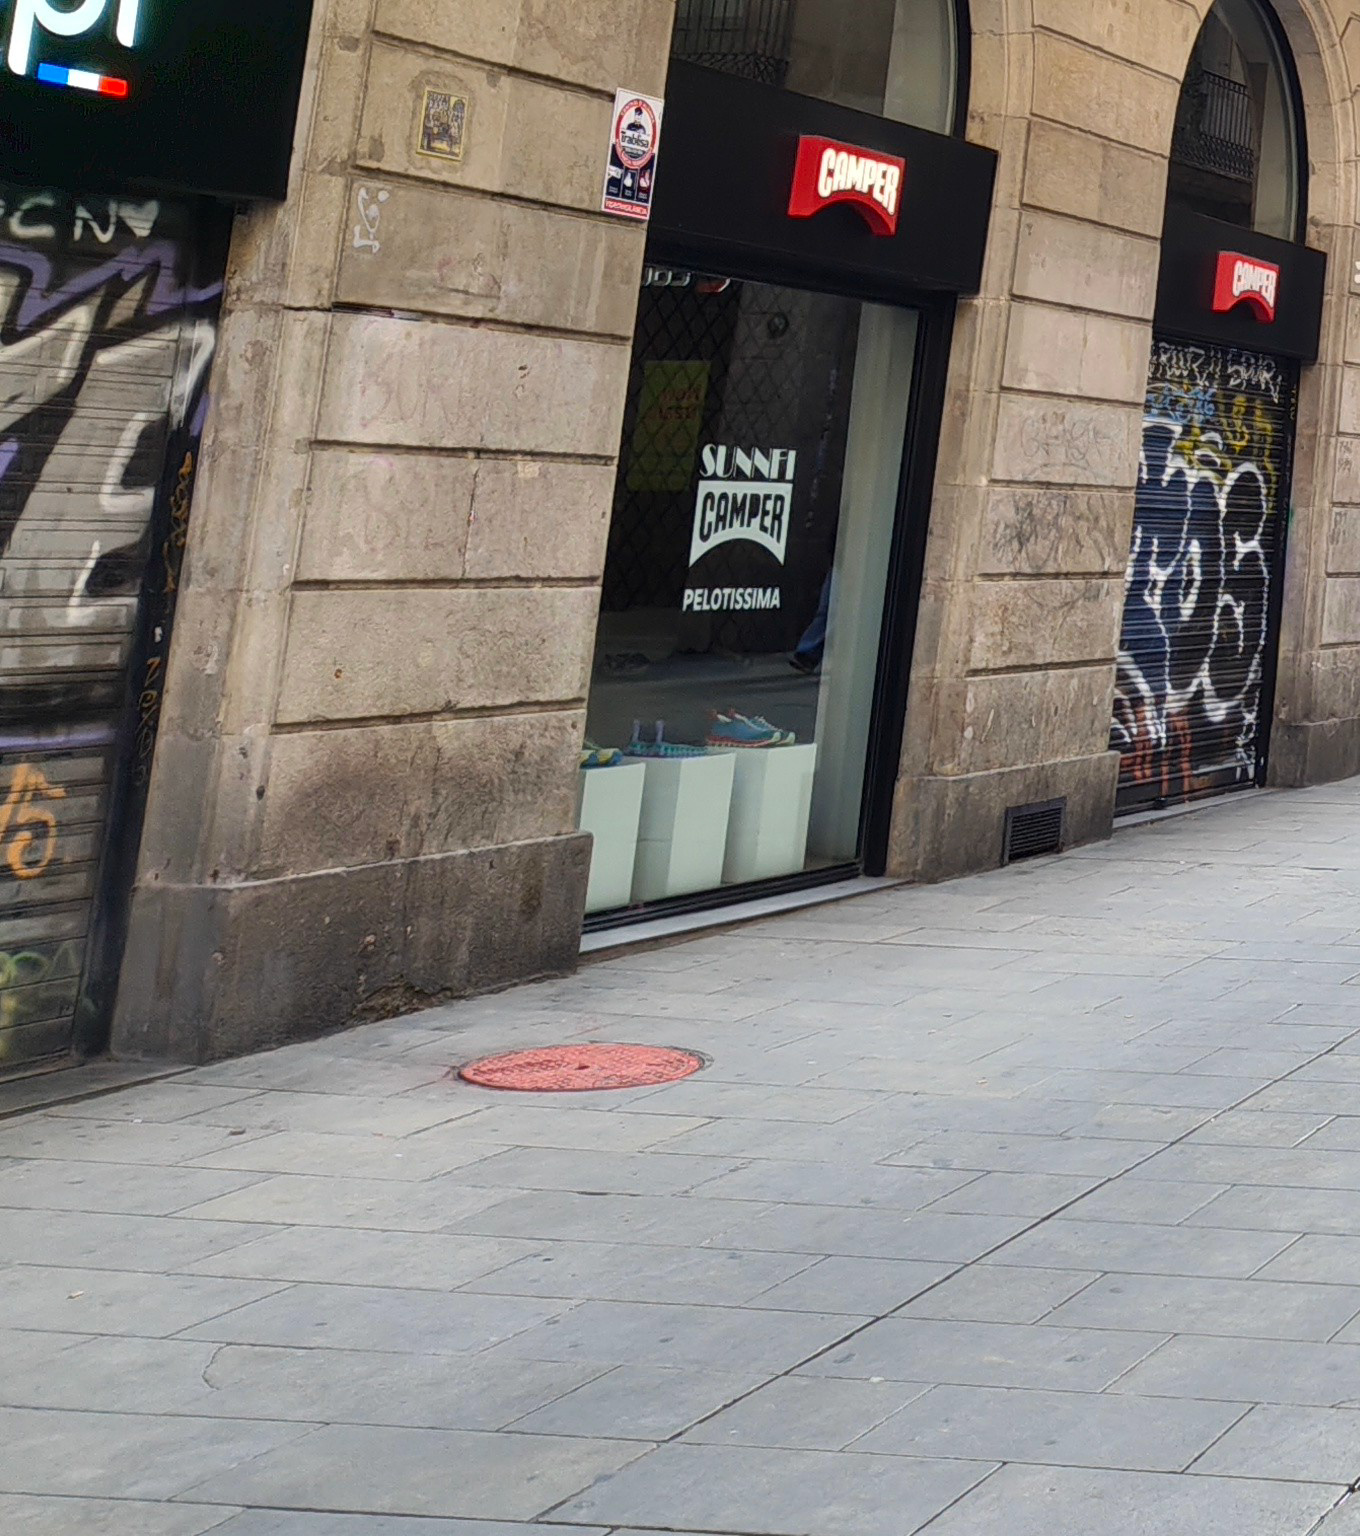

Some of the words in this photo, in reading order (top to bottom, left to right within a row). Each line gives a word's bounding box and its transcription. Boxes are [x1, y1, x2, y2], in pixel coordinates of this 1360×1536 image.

[818, 147, 900, 216] CAMPER
[1232, 259, 1277, 309] CAMPER
[699, 491, 786, 544] CAMPER
[682, 586, 781, 613] PELOTISSIMA
